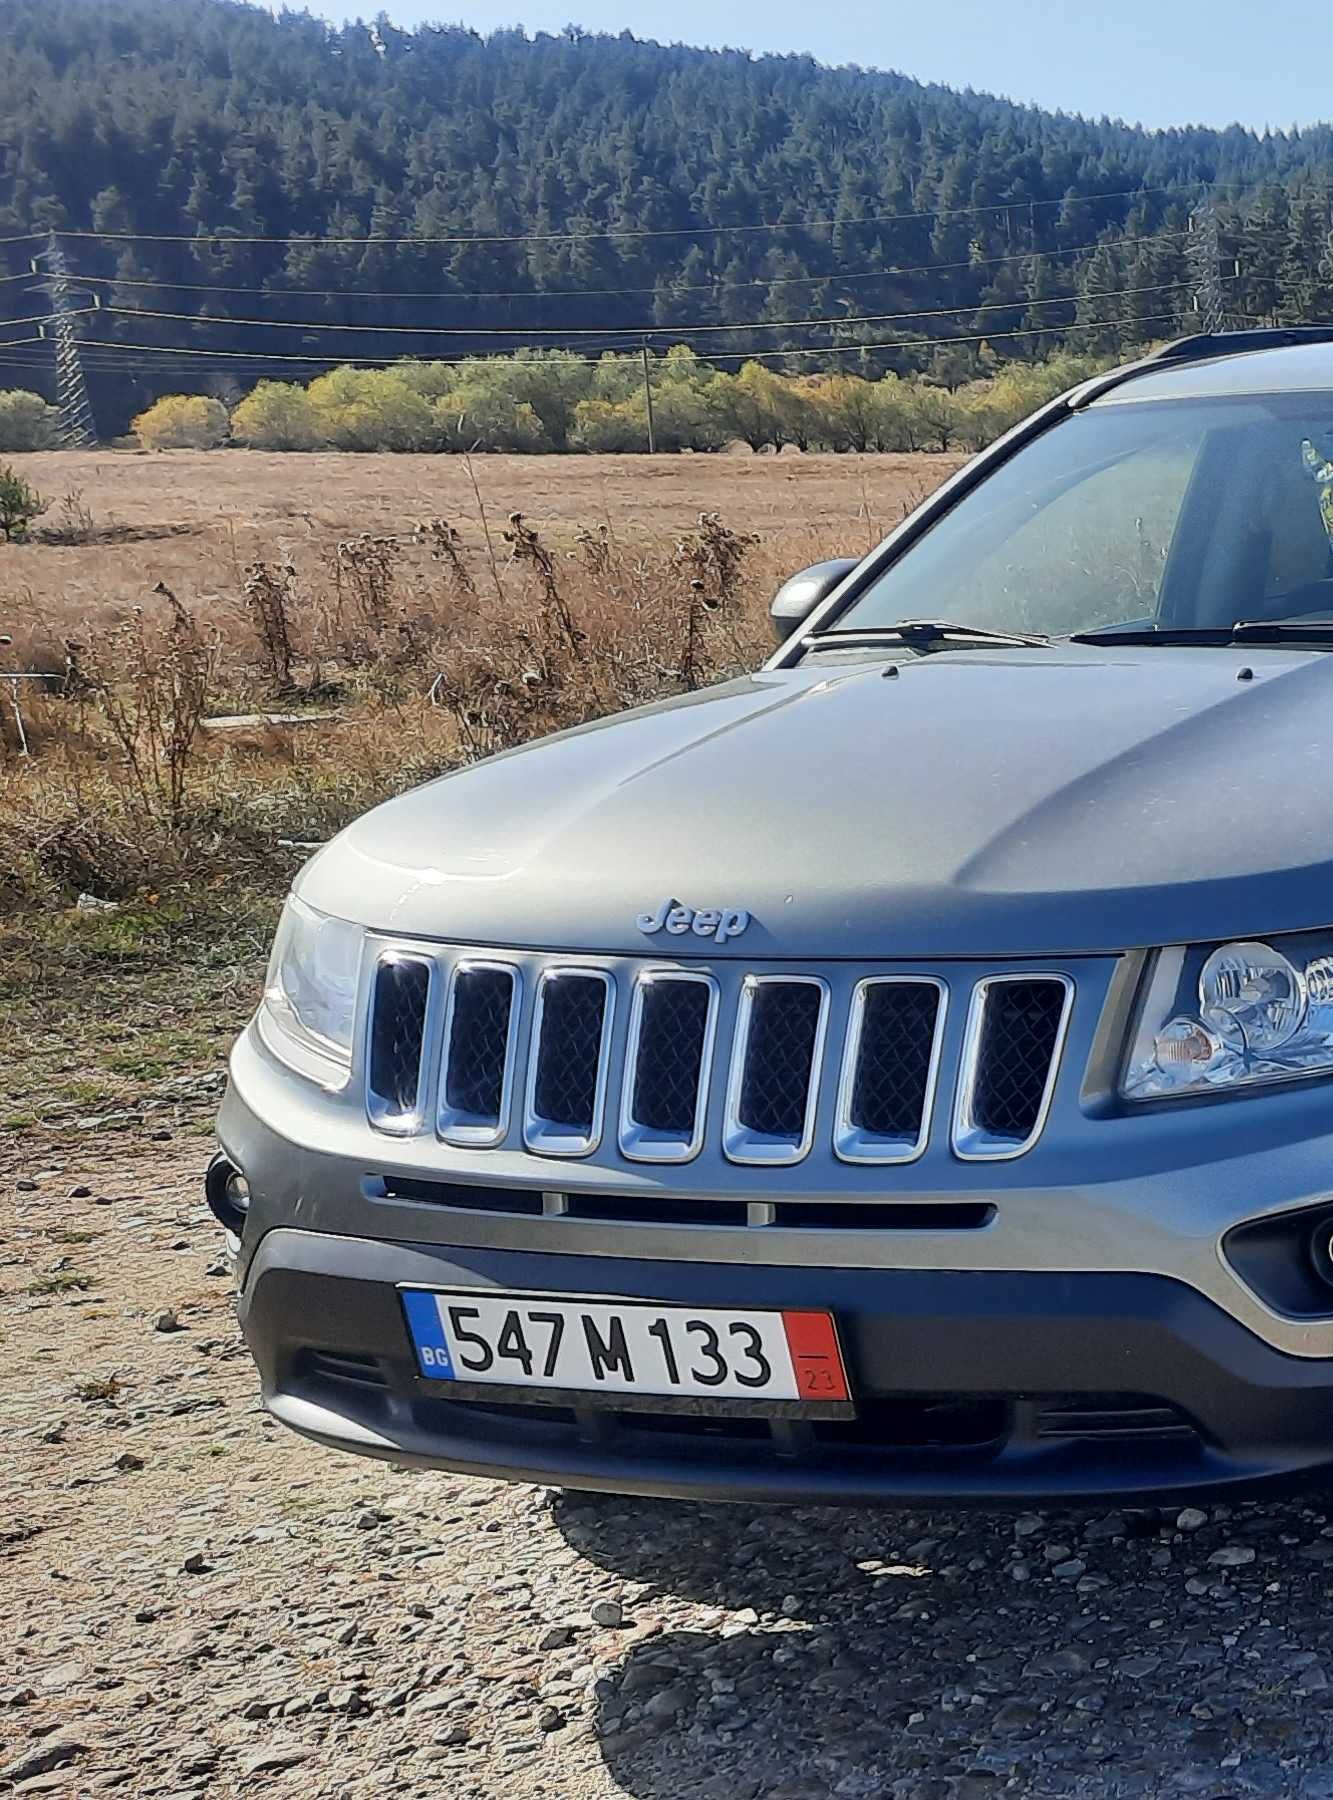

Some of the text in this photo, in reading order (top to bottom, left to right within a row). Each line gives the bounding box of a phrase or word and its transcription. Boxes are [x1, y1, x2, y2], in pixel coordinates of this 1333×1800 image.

[636, 897, 750, 944] Jeep
[421, 1346, 449, 1367] BG
[448, 1306, 772, 1388] 547 M 133
